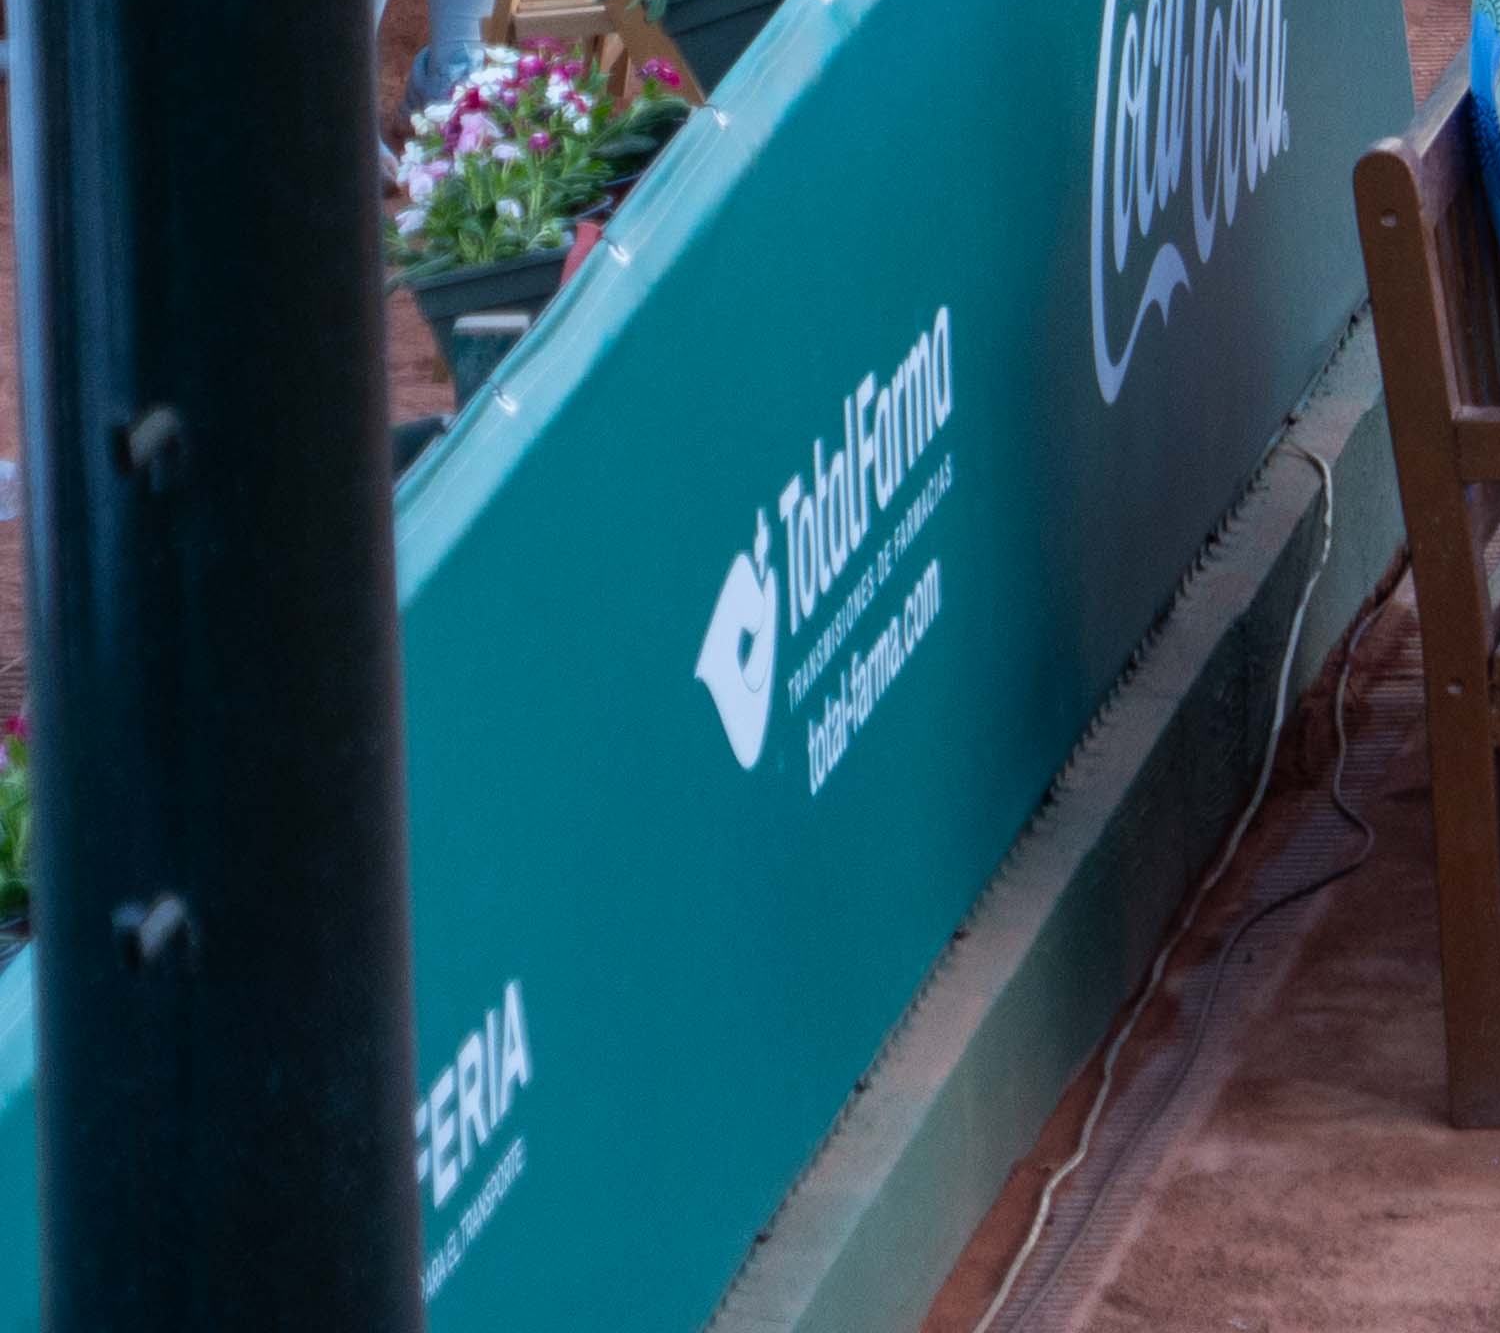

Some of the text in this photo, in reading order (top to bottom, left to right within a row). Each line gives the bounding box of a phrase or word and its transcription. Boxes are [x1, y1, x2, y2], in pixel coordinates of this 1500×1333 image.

[779, 304, 953, 636] TotalFarma
[787, 452, 954, 714] TRANSMISIONES DE FARMACIAS
[807, 557, 941, 798] total-farma.com
